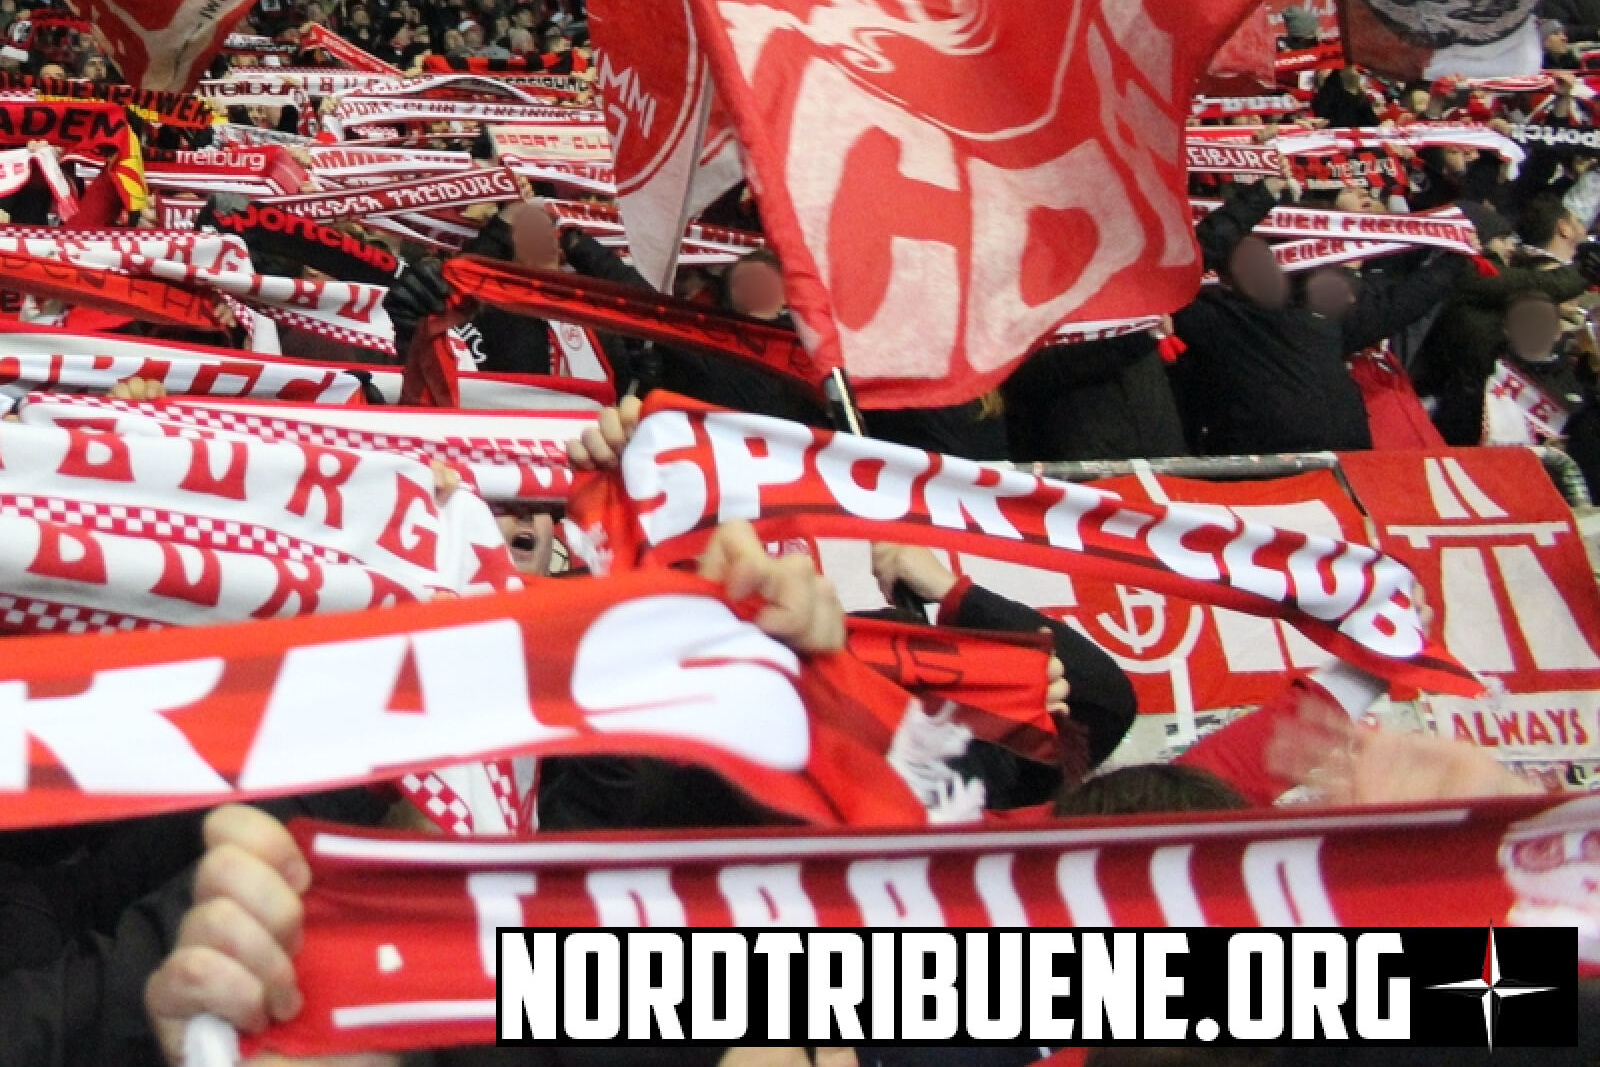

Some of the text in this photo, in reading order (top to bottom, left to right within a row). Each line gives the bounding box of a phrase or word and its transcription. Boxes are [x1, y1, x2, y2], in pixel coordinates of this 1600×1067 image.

[175, 142, 266, 172] freiburg
[387, 171, 516, 208] FREIBURG
[622, 409, 1428, 659] SPORT-CLUB
[1451, 707, 1586, 748] ALWAYS
